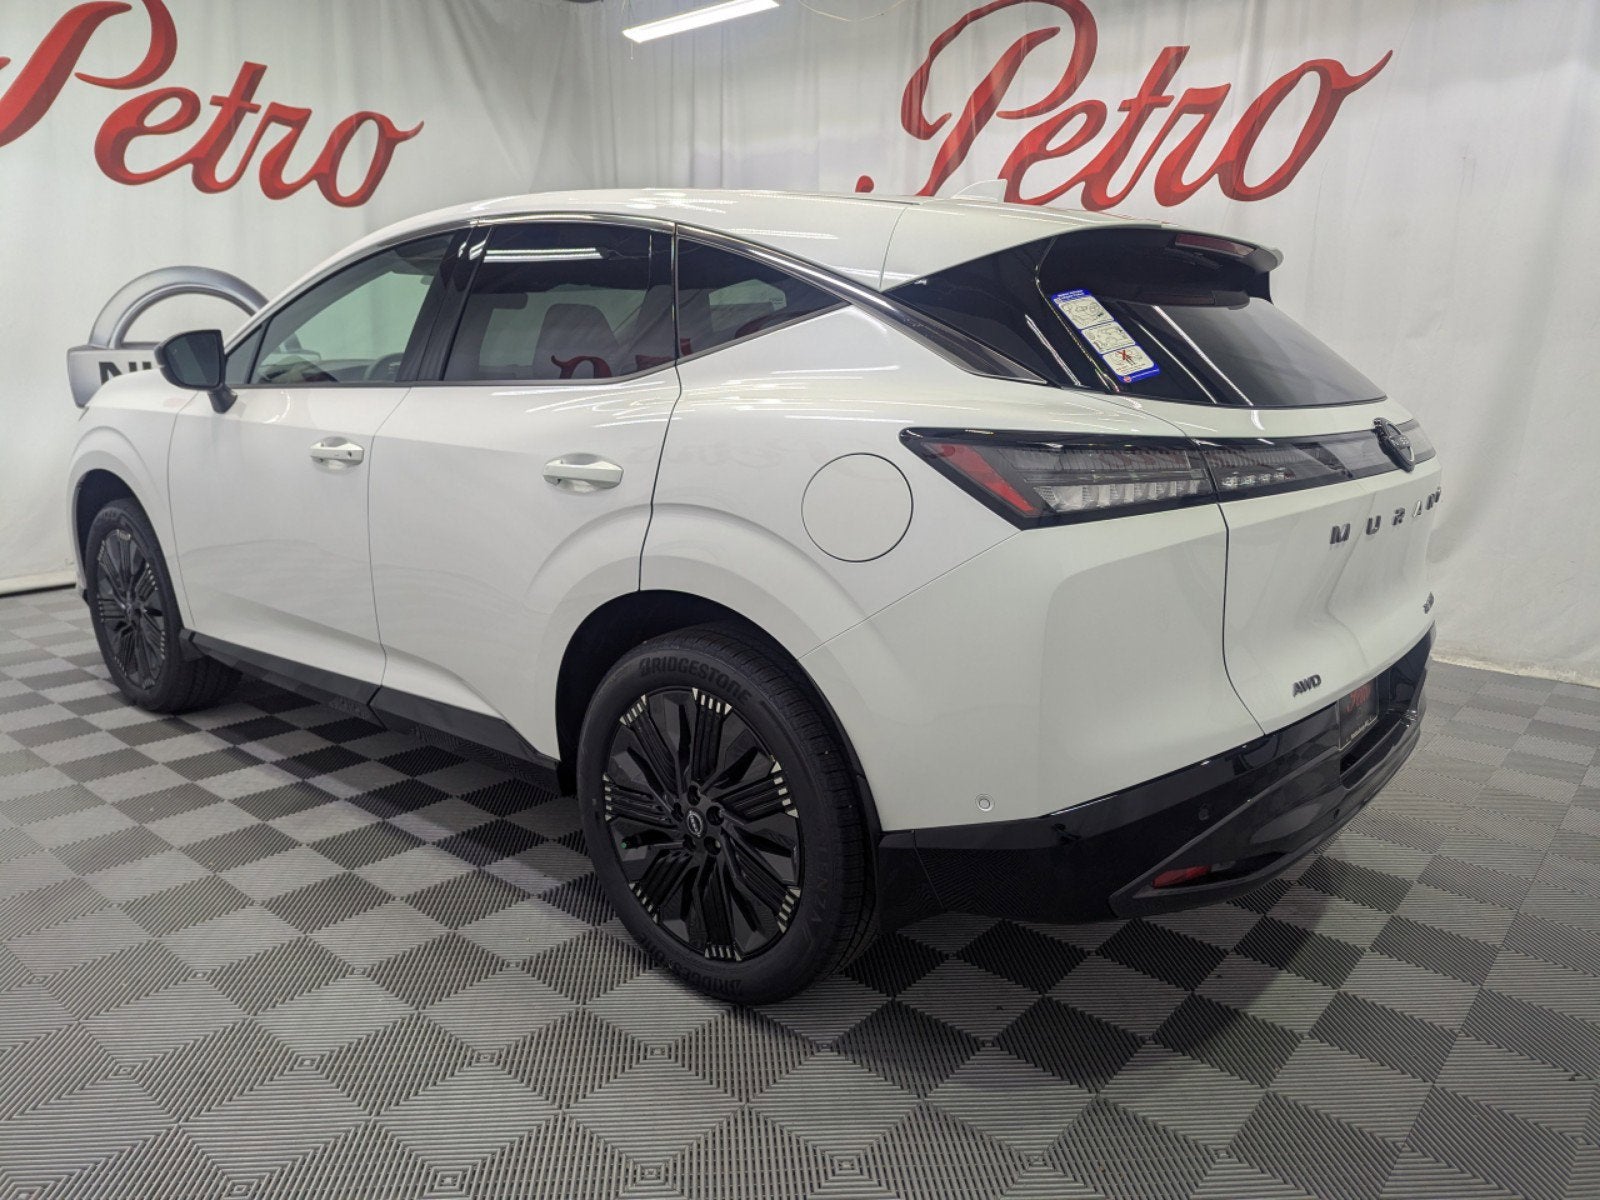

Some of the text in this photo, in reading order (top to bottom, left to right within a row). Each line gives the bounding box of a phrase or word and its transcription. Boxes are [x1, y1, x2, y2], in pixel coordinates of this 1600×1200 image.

[0, 0, 425, 207] Petro
[901, 0, 1393, 207] Petro
[1329, 486, 1442, 545] MURAN
[639, 656, 753, 704] BRIDGESTONE
[1292, 673, 1322, 697] AWD
